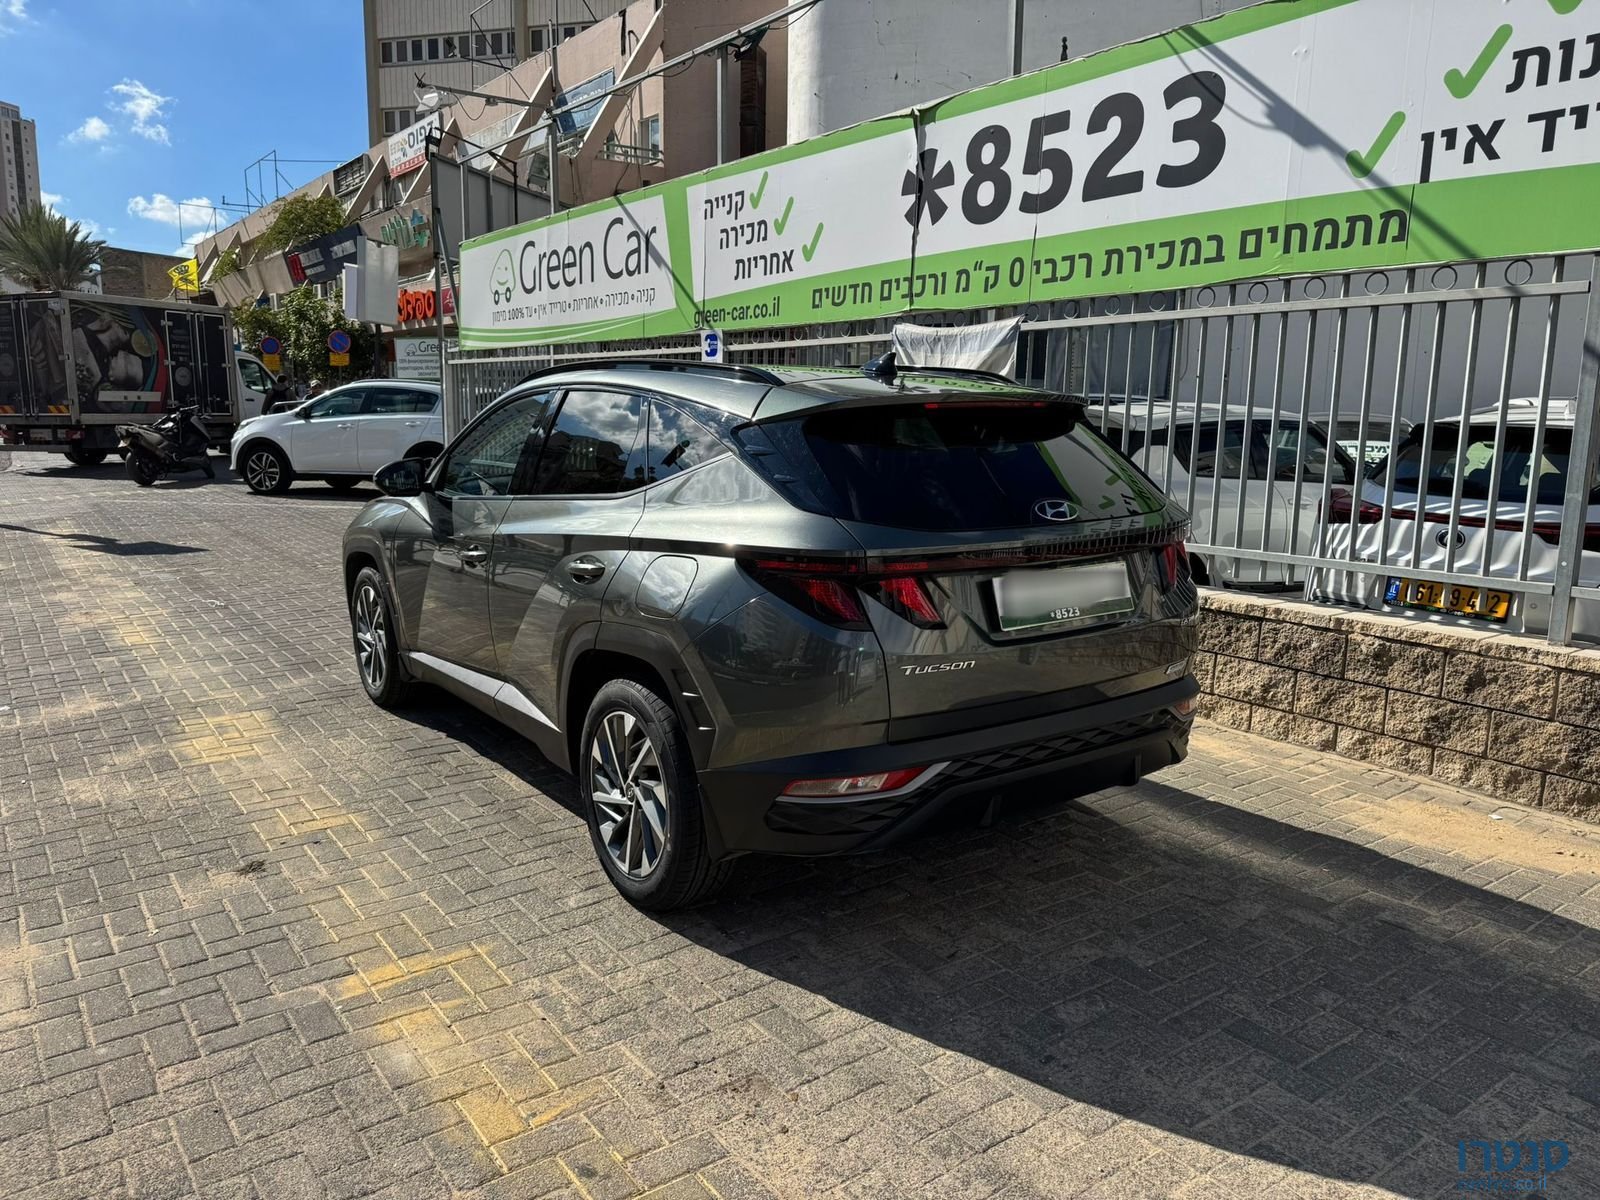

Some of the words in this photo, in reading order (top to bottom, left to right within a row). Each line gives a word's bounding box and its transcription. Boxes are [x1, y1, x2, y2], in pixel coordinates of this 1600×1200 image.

[1527, 101, 1600, 153] יד
[1419, 118, 1506, 184] אין
[704, 189, 745, 221] קנייה
[719, 220, 768, 250] מכירה
[1238, 209, 1407, 260] מתמחים
[519, 240, 595, 295] Green
[602, 217, 657, 280] Car
[733, 248, 794, 282] אחריות
[1032, 252, 1093, 285] רכבי
[1101, 234, 1225, 279] במכירת
[880, 271, 947, 302] ורכבים
[1009, 256, 1024, 288] 0
[548, 300, 567, 315] טרייד
[572, 295, 599, 312] אחריות
[605, 291, 629, 307] מכירה
[636, 287, 656, 306] קניה
[811, 281, 873, 310] חדשים
[508, 307, 525, 321] 100%
[524, 306, 533, 318] עד
[537, 303, 548, 320] אין
[694, 296, 780, 328] green-car.co.il
